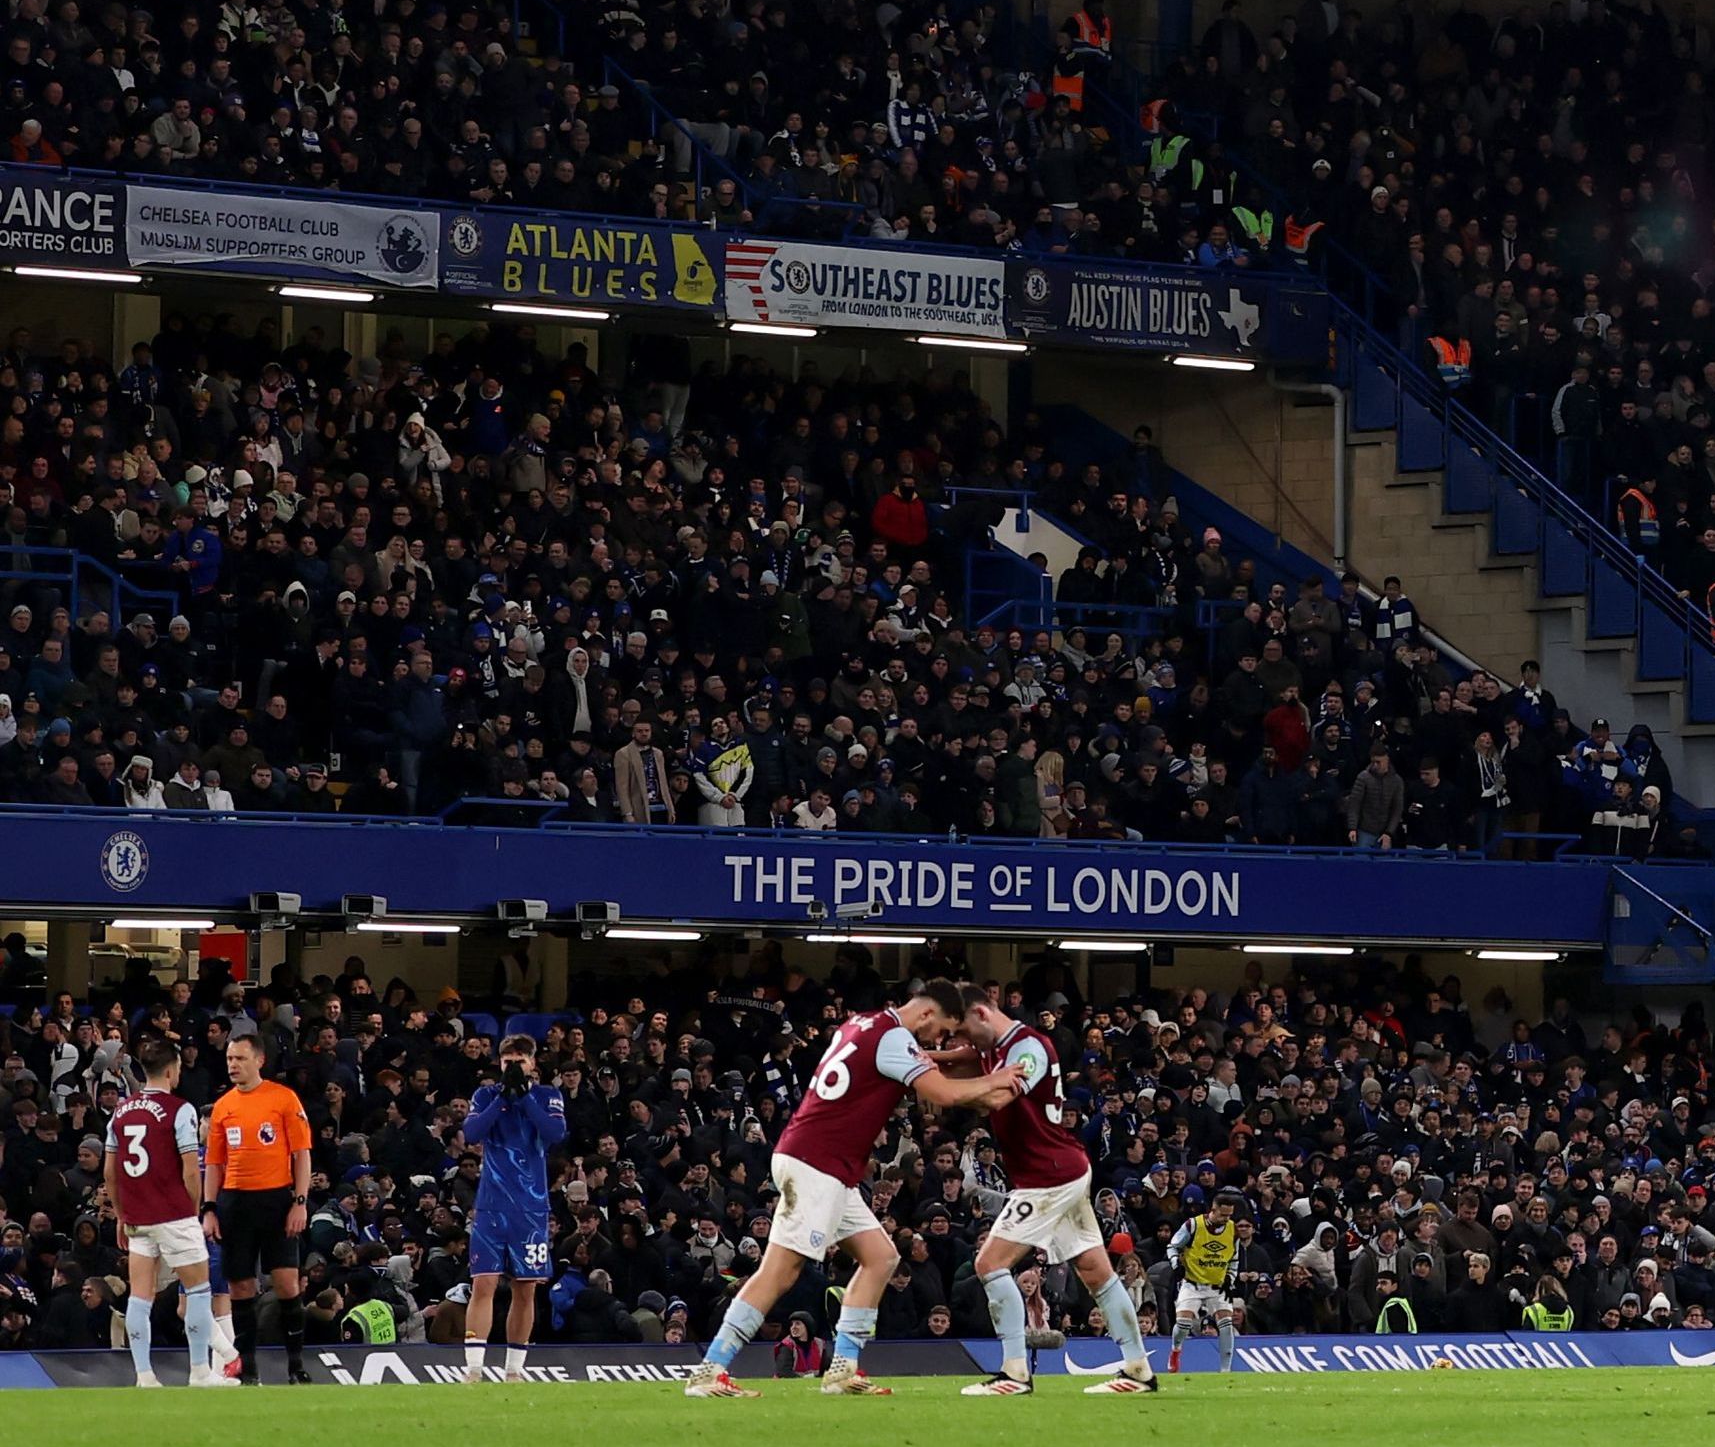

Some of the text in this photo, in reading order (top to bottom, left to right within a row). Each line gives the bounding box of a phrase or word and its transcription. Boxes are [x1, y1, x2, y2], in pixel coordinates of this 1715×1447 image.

[0, 187, 115, 232] ANCE
[140, 206, 339, 237] CHELSEA FOOTBALL CLUB
[71, 236, 114, 254] CLUB
[140, 231, 365, 265] MUSLIM SUPPORTERS GROUP
[506, 223, 657, 266] ATLANTA
[504, 260, 657, 300] BLUES
[927, 273, 1000, 311] BLUES
[821, 299, 846, 313] FROM
[849, 302, 888, 318] LONDON
[889, 305, 902, 318] TO
[902, 307, 922, 320] THE
[981, 313, 1000, 327] USA
[1067, 283, 1211, 337] AUSTIN BLUES
[724, 855, 1240, 917] THE PRIDE OF LONDON
[116, 1099, 168, 1122] CRESSWELL
[123, 1125, 149, 1178] 3
[524, 1243, 548, 1264] 38
[586, 1363, 702, 1382] ATHLET
